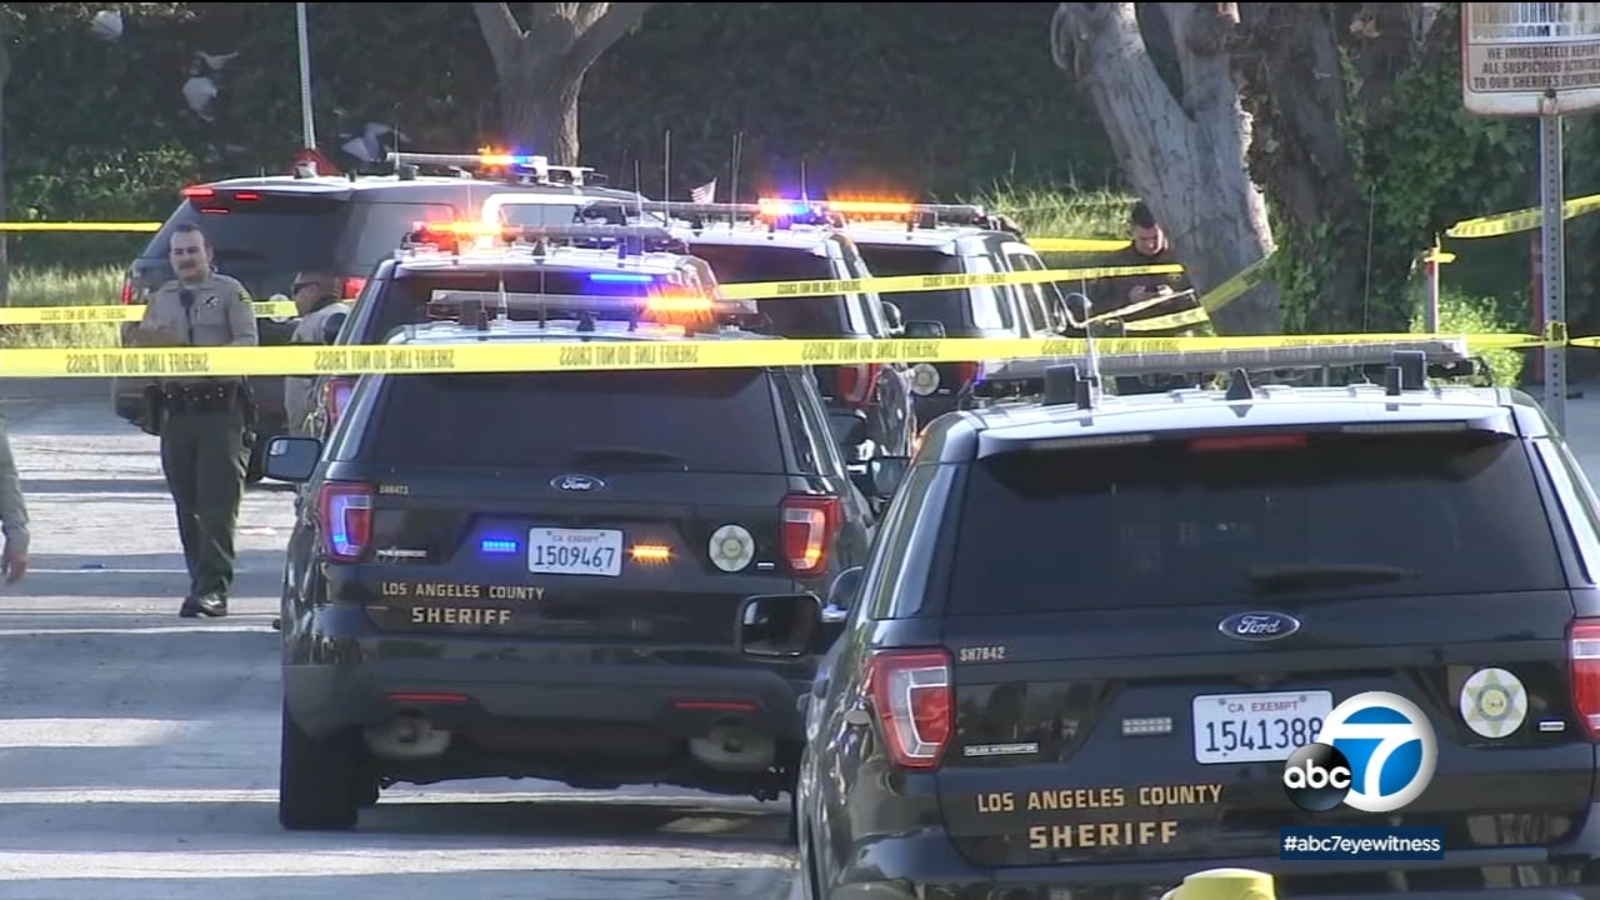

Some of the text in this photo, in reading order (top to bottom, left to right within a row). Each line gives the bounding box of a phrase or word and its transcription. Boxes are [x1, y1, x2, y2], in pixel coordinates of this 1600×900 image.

[1483, 62, 1499, 74] ALL
[1503, 61, 1561, 73] SUSPICIOUS
[1474, 77, 1487, 89] TO
[1489, 77, 1510, 88] OUR
[562, 477, 592, 490] Ford
[535, 545, 615, 568] 1509467
[382, 582, 545, 600] LOS ANGELES COUNTY
[412, 606, 511, 625] SHERIFF
[1237, 615, 1281, 634] Ford
[1227, 701, 1299, 713] CA EXEMPT
[977, 784, 1222, 812] LOS ANGELES COUNTY
[1029, 821, 1178, 849] SHERIFF
